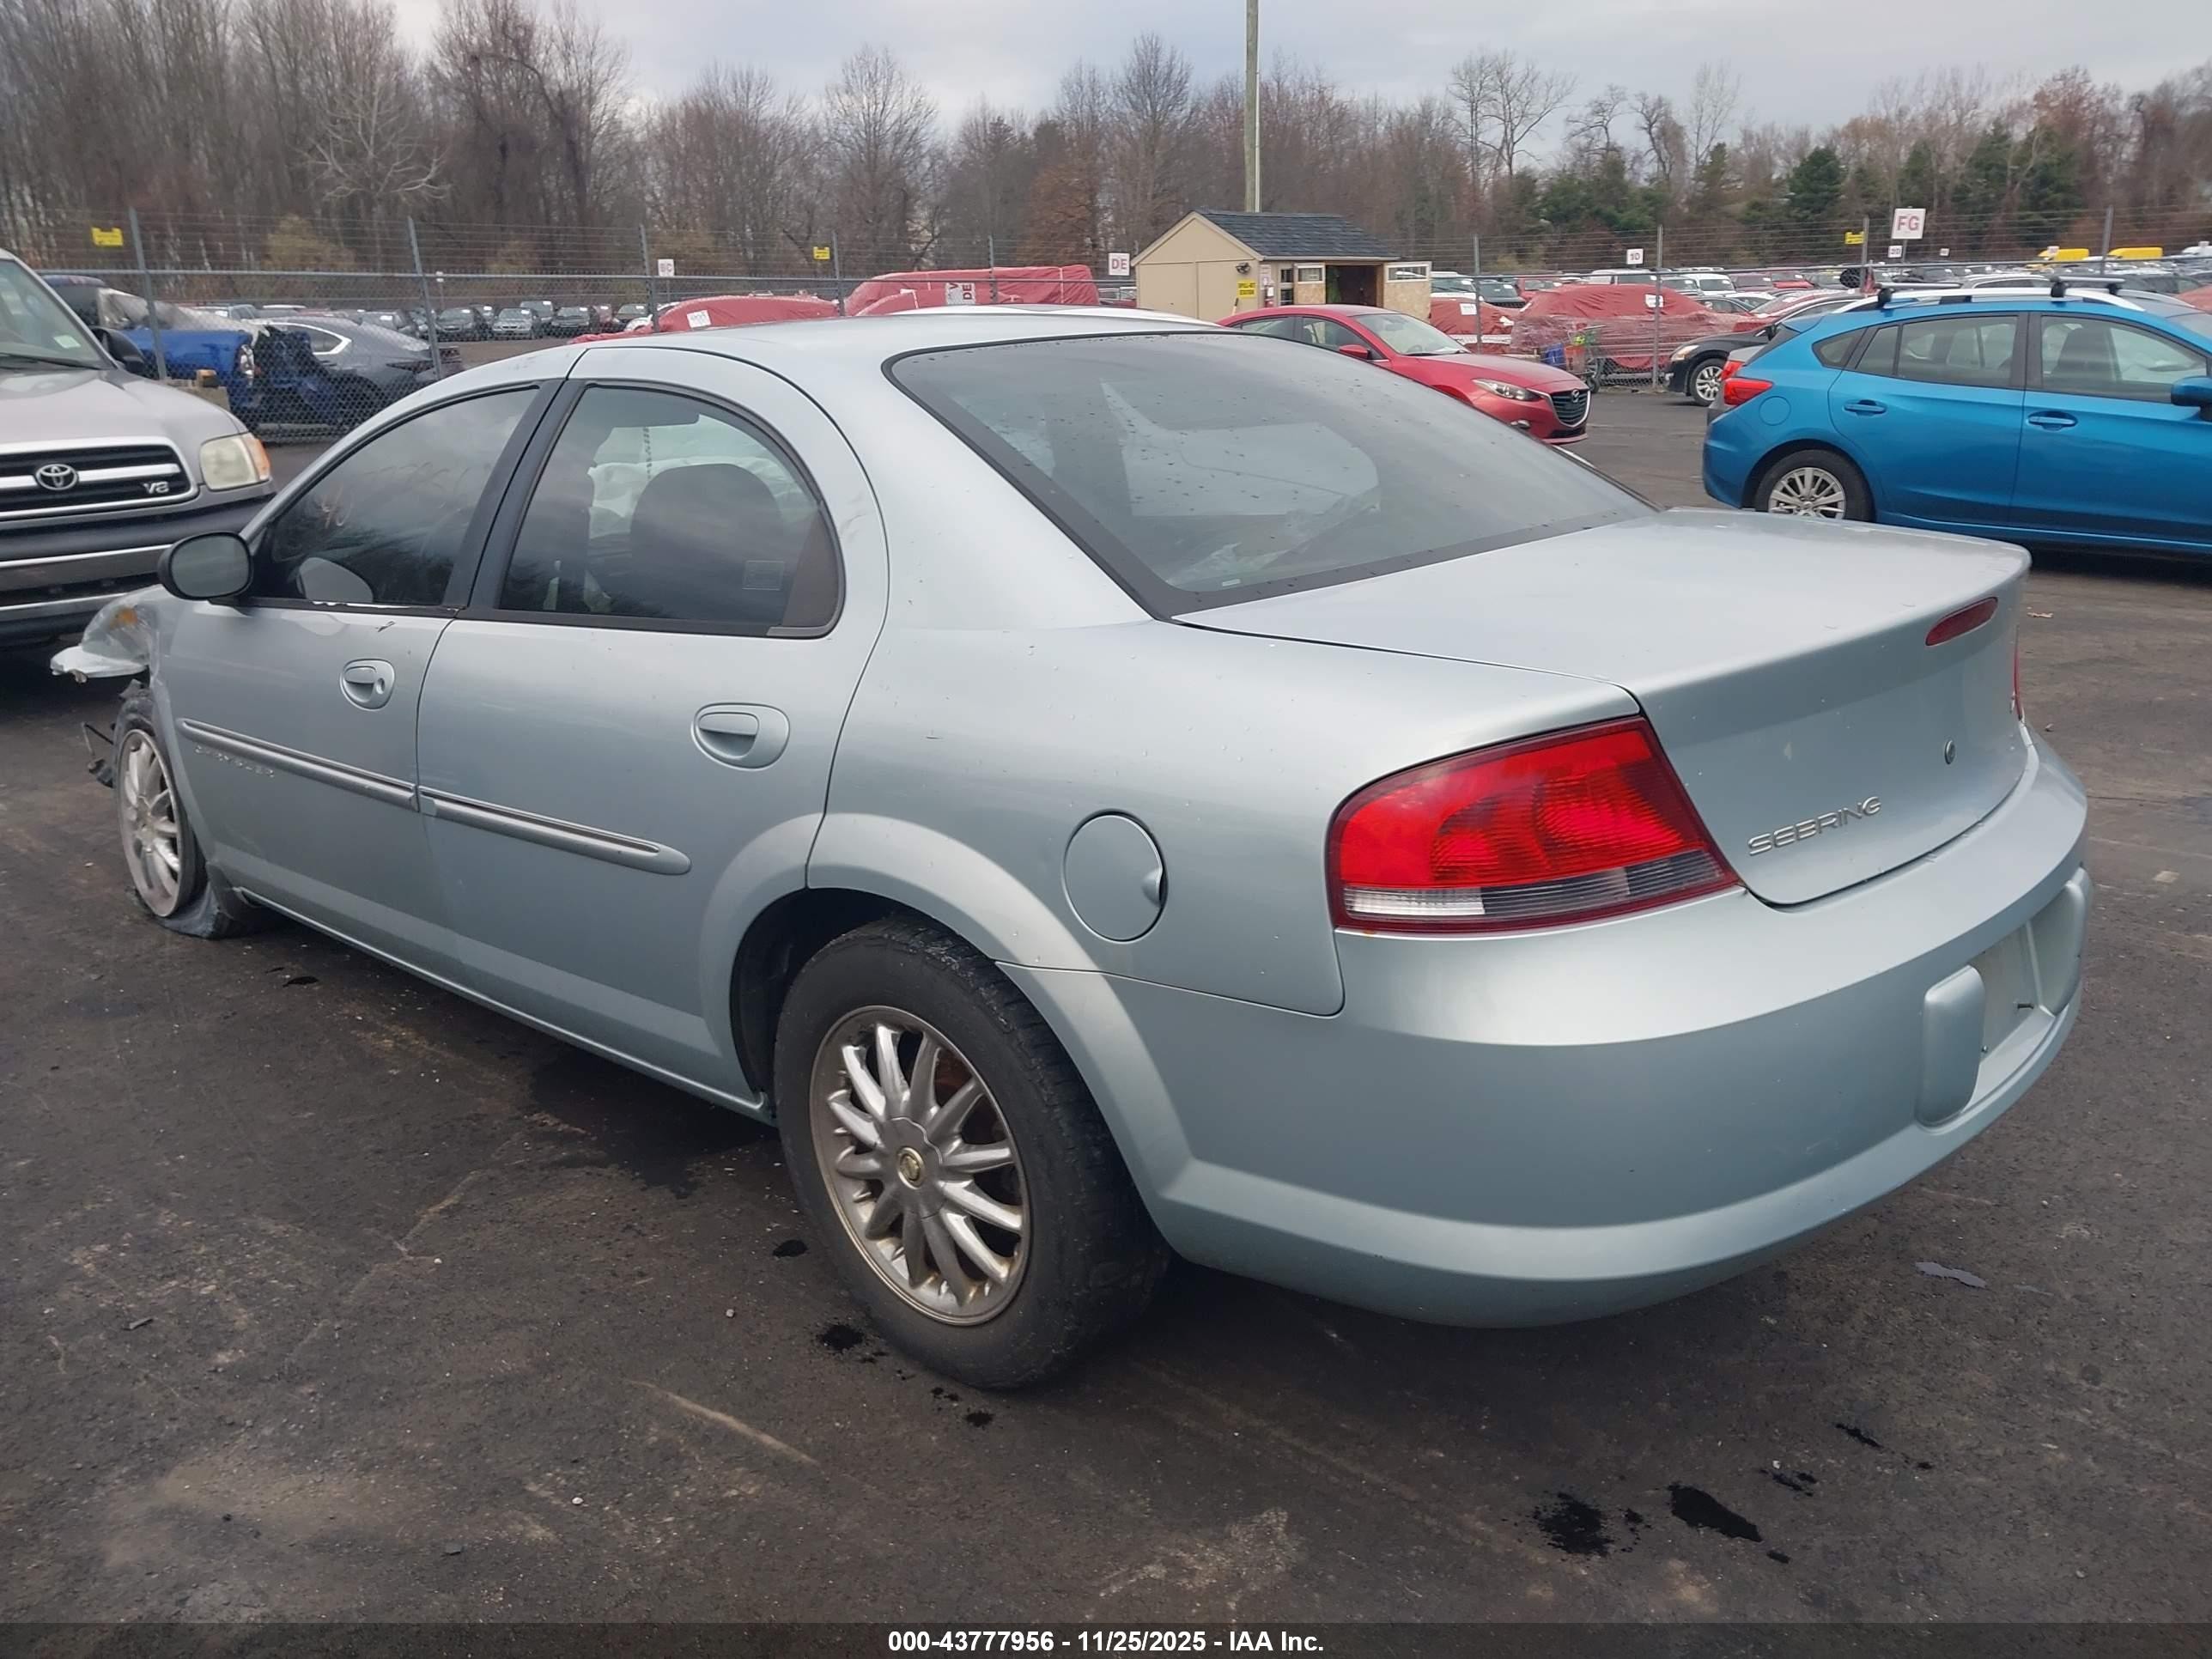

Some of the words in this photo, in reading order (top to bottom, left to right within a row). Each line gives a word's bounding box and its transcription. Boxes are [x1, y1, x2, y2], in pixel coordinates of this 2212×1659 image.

[1897, 216, 1920, 231] FG
[1112, 258, 1127, 270] DE
[962, 284, 972, 300] DE
[1747, 796, 1882, 857] SEBRING
